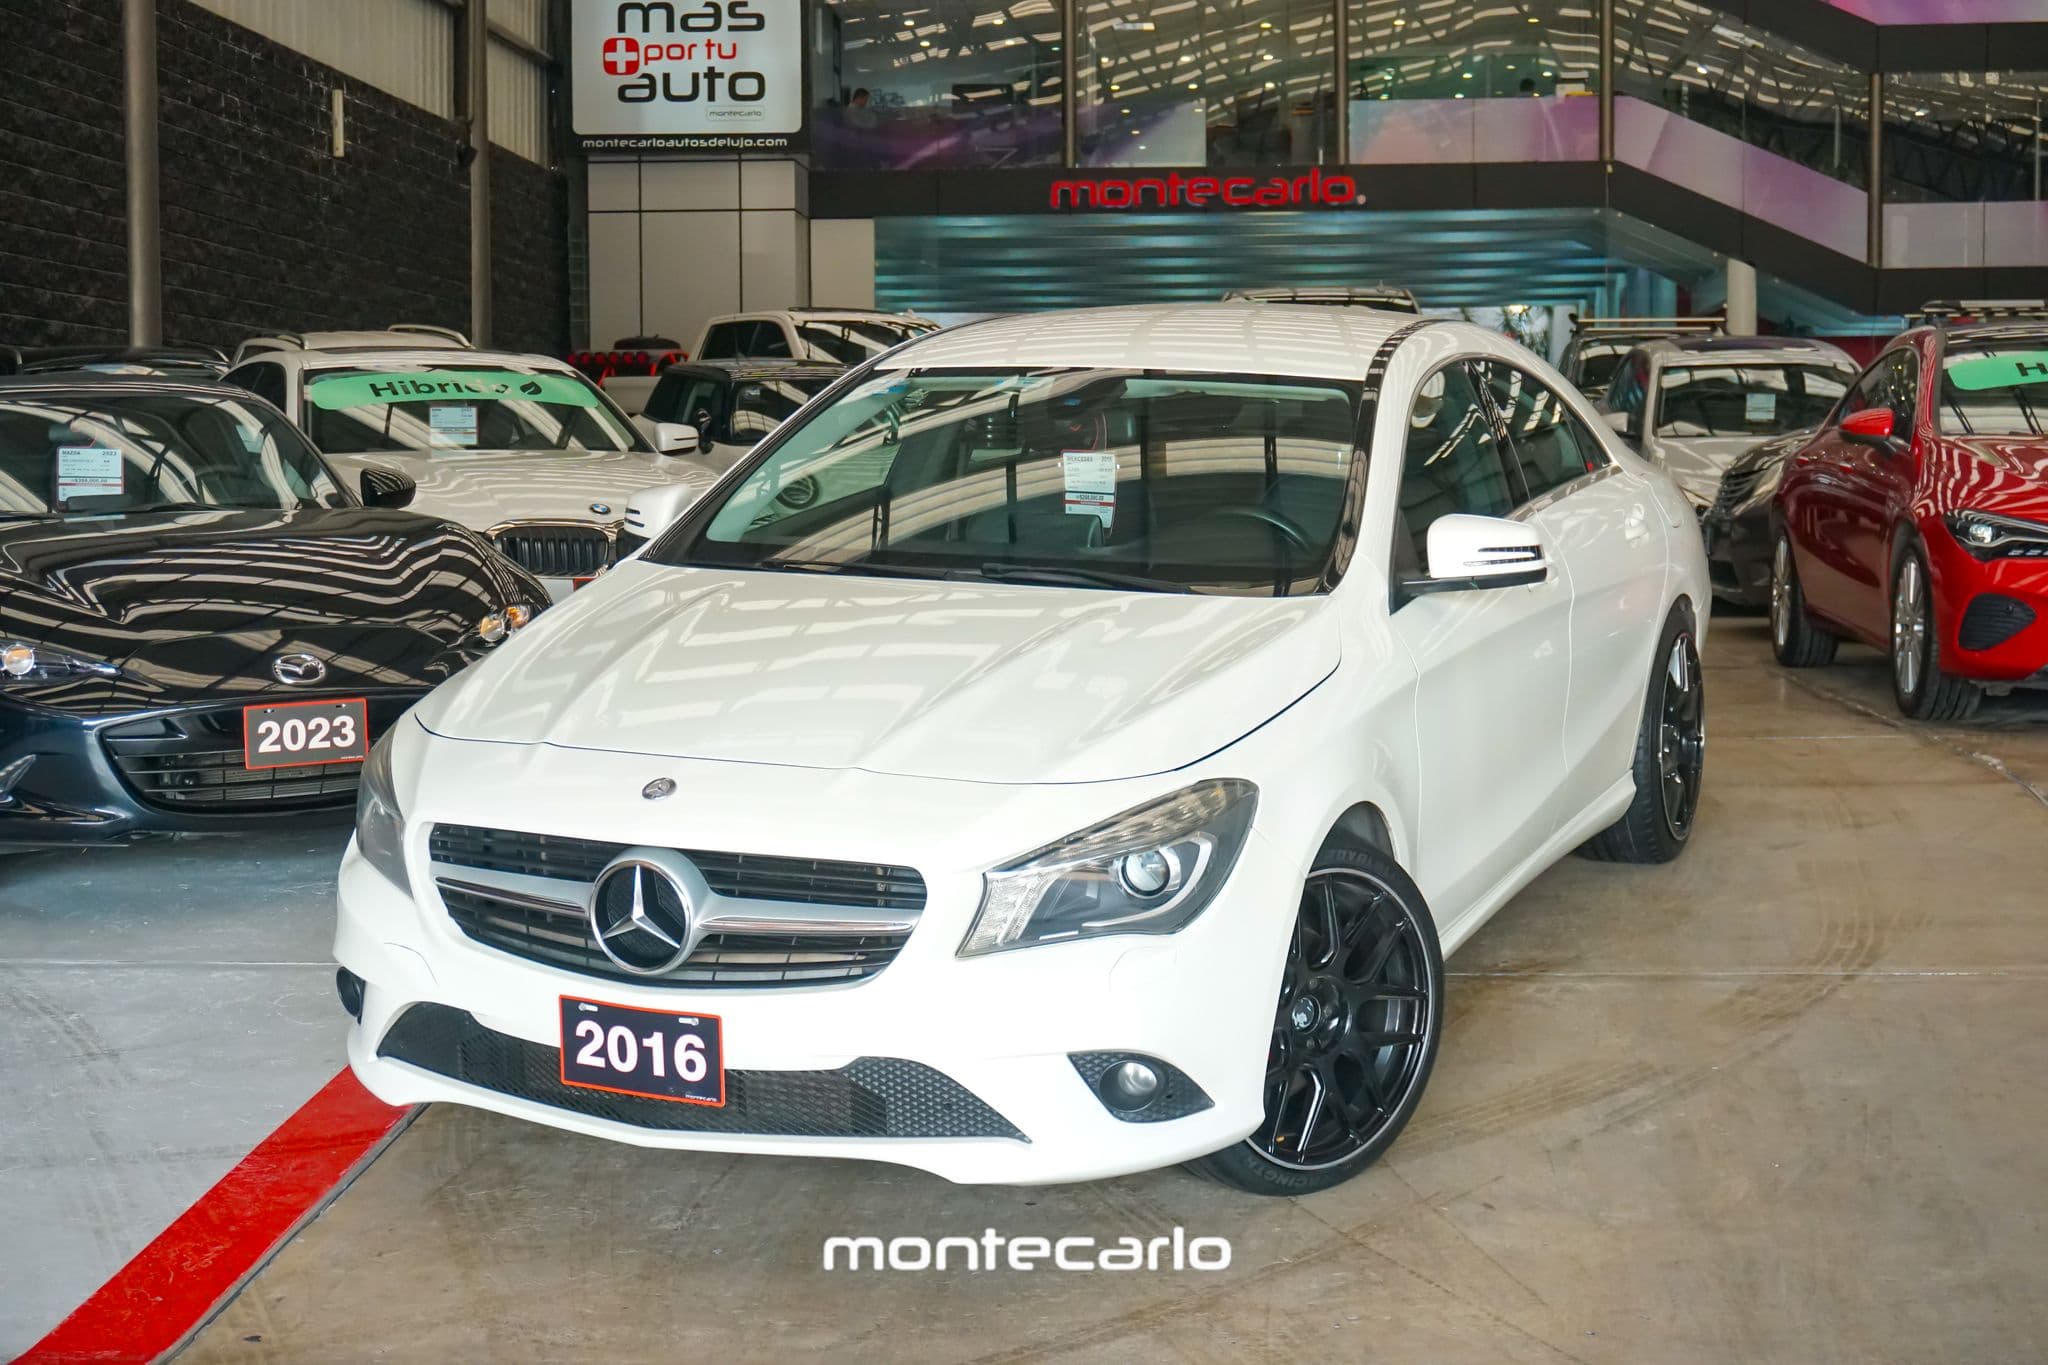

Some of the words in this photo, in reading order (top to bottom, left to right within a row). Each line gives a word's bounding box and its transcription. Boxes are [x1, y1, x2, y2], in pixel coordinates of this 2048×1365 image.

[617, 1, 765, 33] mas
[643, 43, 697, 66] por
[705, 38, 737, 60] tu
[617, 66, 766, 103] auto
[708, 109, 762, 118] montecarlo
[582, 136, 788, 149] montecarloautosdelujo.com
[257, 715, 356, 754] 2023
[575, 1019, 707, 1083] 2016
